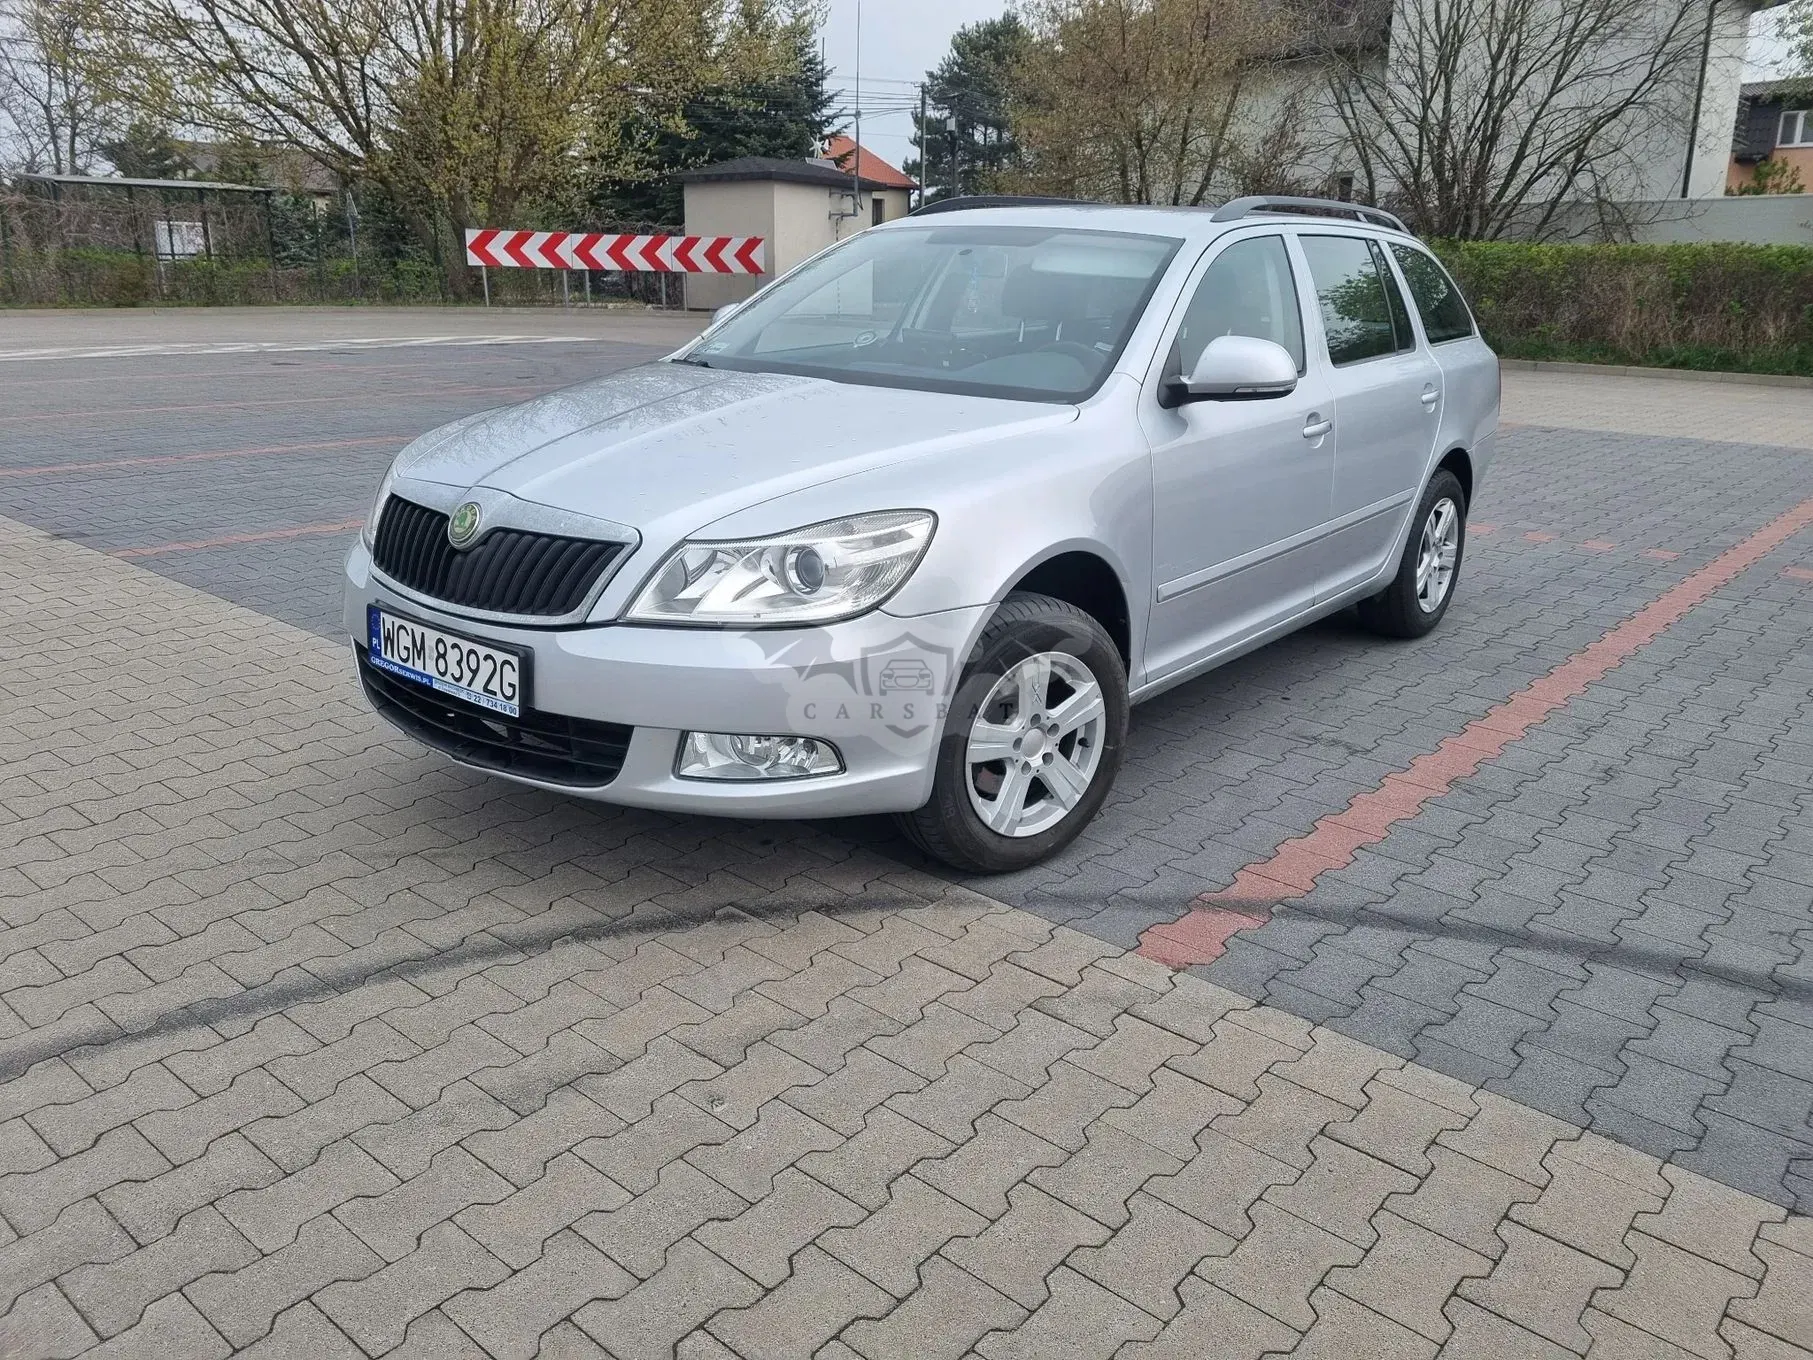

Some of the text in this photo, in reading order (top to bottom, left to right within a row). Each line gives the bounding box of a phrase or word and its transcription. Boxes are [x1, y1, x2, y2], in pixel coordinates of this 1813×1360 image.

[372, 637, 381, 650] PL
[382, 617, 517, 701] WGM 8392G
